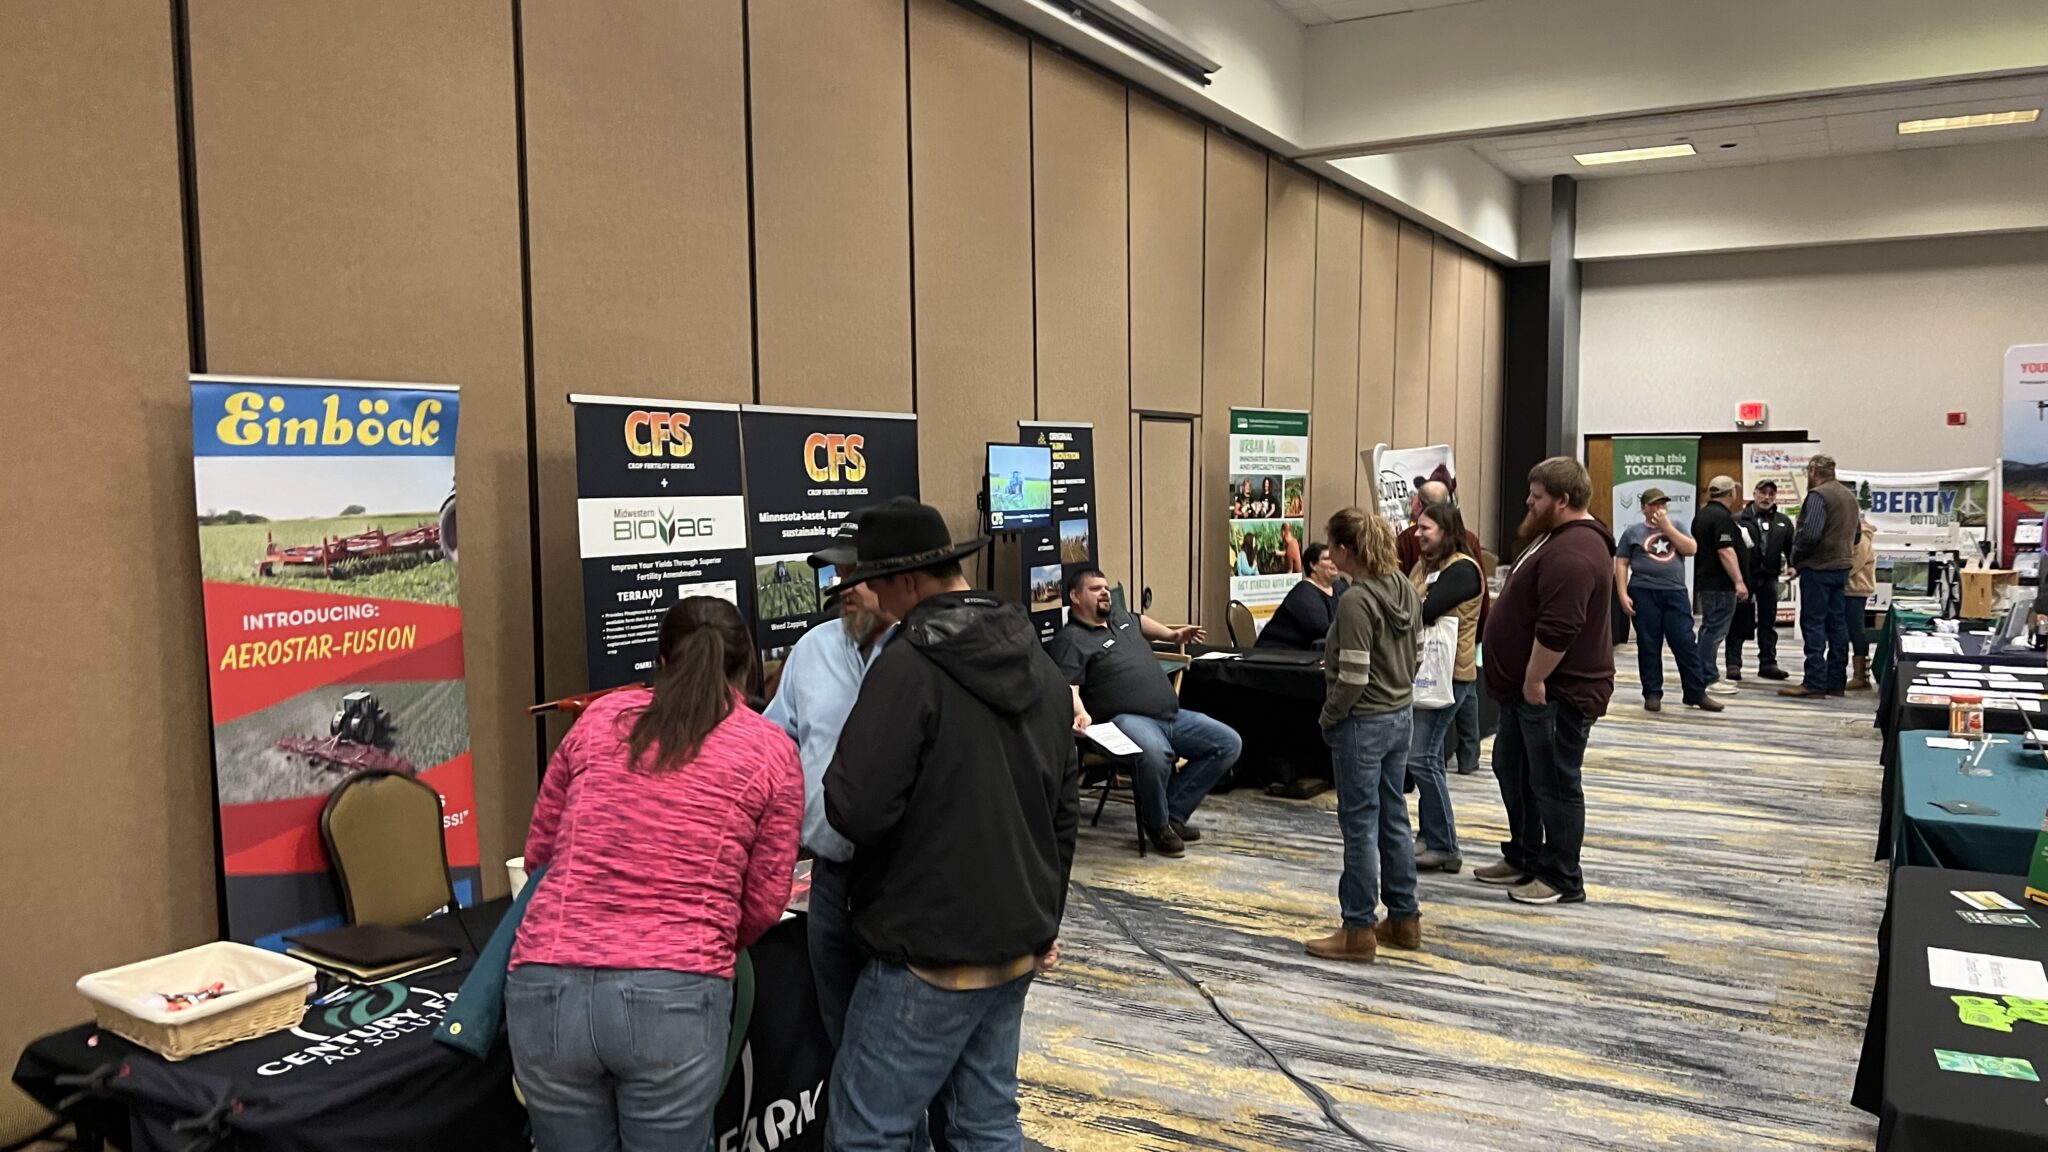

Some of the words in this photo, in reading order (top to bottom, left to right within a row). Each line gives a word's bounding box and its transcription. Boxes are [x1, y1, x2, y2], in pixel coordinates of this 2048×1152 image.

[216, 391, 442, 446] Einböck
[624, 410, 693, 457] CFS
[804, 432, 866, 482] CFS
[1625, 453, 1654, 464] We're
[1655, 453, 1665, 463] in
[1667, 453, 1687, 463] this
[1625, 464, 1686, 476] TOGETHER.
[614, 508, 655, 518] Midwestern
[759, 510, 827, 523] Minnesota-based,
[782, 524, 826, 538] sustainable
[611, 562, 638, 573] Improve
[639, 560, 654, 569] Your
[655, 559, 673, 569] Yields
[673, 557, 698, 568] Through
[699, 556, 722, 566] Superior
[636, 572, 662, 582] Fertility
[662, 569, 703, 579] Amendments
[243, 603, 380, 630] INTRODUCING:
[771, 622, 786, 631] Weed
[786, 620, 808, 630] Zapping
[220, 624, 417, 671] AEROSTAR-FUSION
[256, 1008, 424, 1077] CENTURY
[323, 1047, 361, 1066] AG
[364, 1013, 447, 1047] SOLUT
